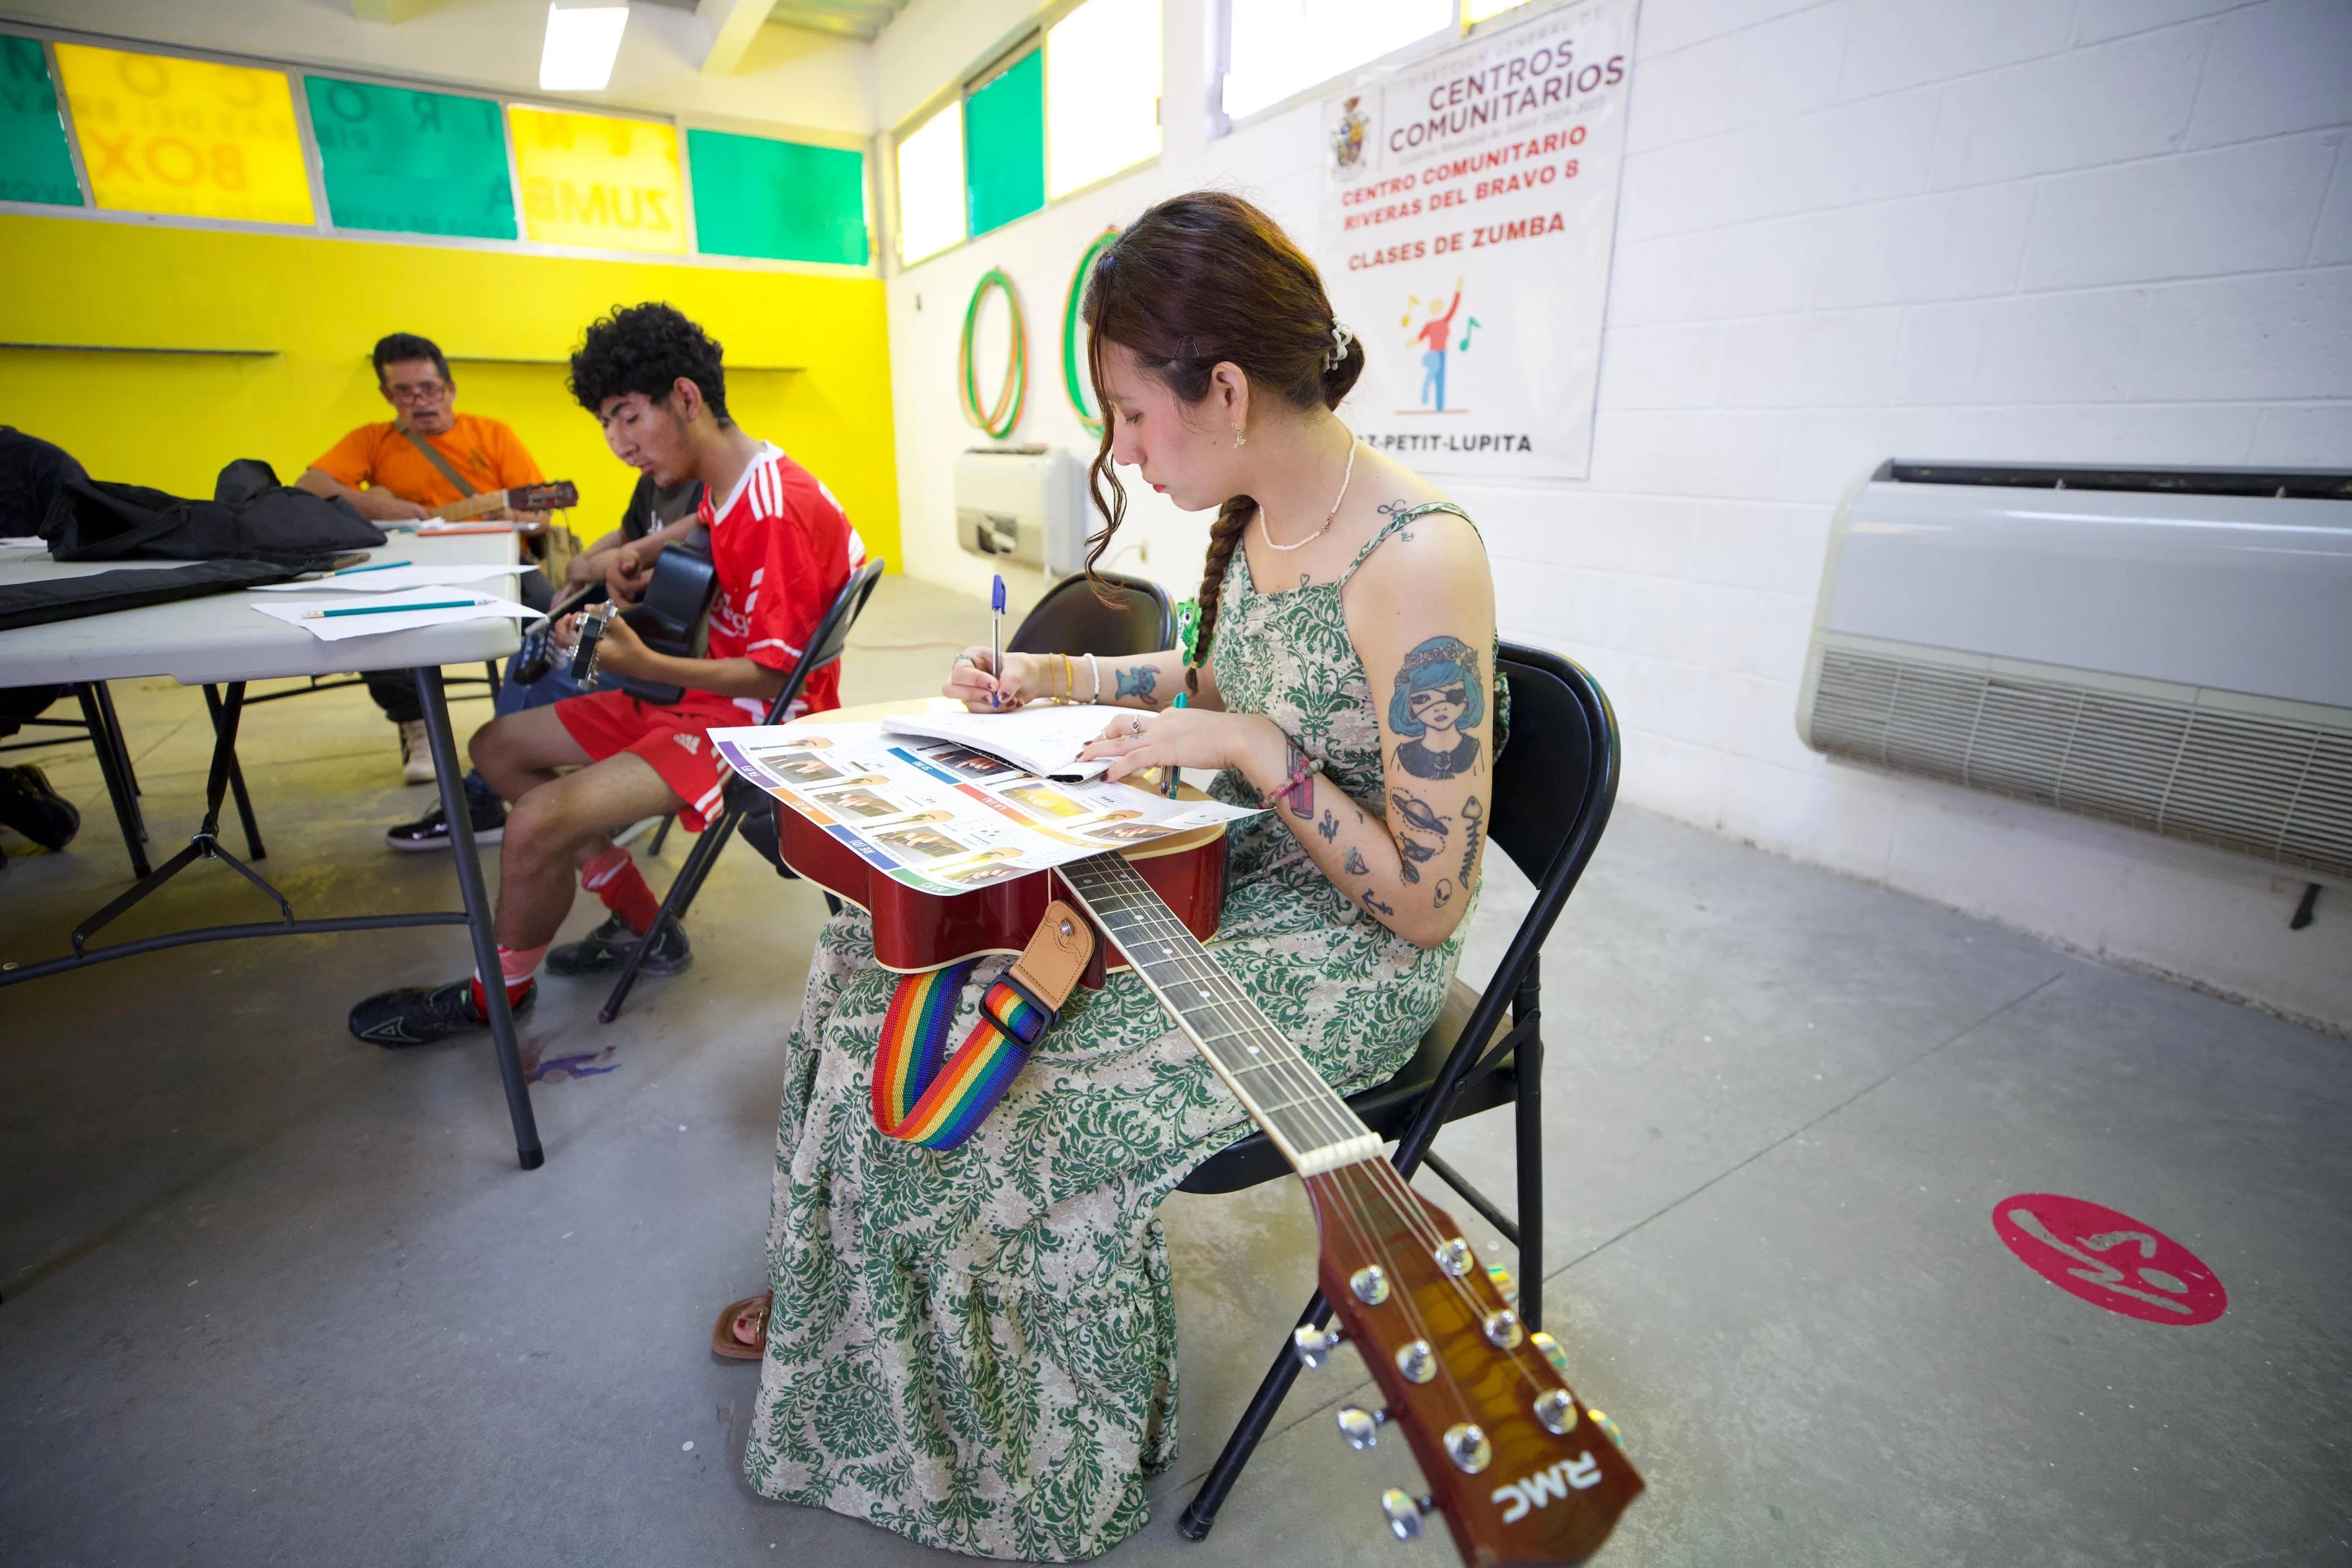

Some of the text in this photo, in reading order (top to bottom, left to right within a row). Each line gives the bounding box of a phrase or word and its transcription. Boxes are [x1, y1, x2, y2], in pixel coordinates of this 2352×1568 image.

[1389, 55, 1625, 153] COMUNITARIOS
[1429, 40, 1574, 111] CENTROS
[1341, 125, 1588, 207] CENTRO COMUNITARIO
[1343, 198, 1421, 231] RIVERAS
[1429, 187, 1467, 211] DEL
[1476, 166, 1556, 201] BRAVO
[1348, 212, 1566, 272] CLASES DE ZUMBA
[849, 839, 864, 848] (D)
[860, 844, 875, 854] RE
[1491, 1450, 1602, 1524] RMC
